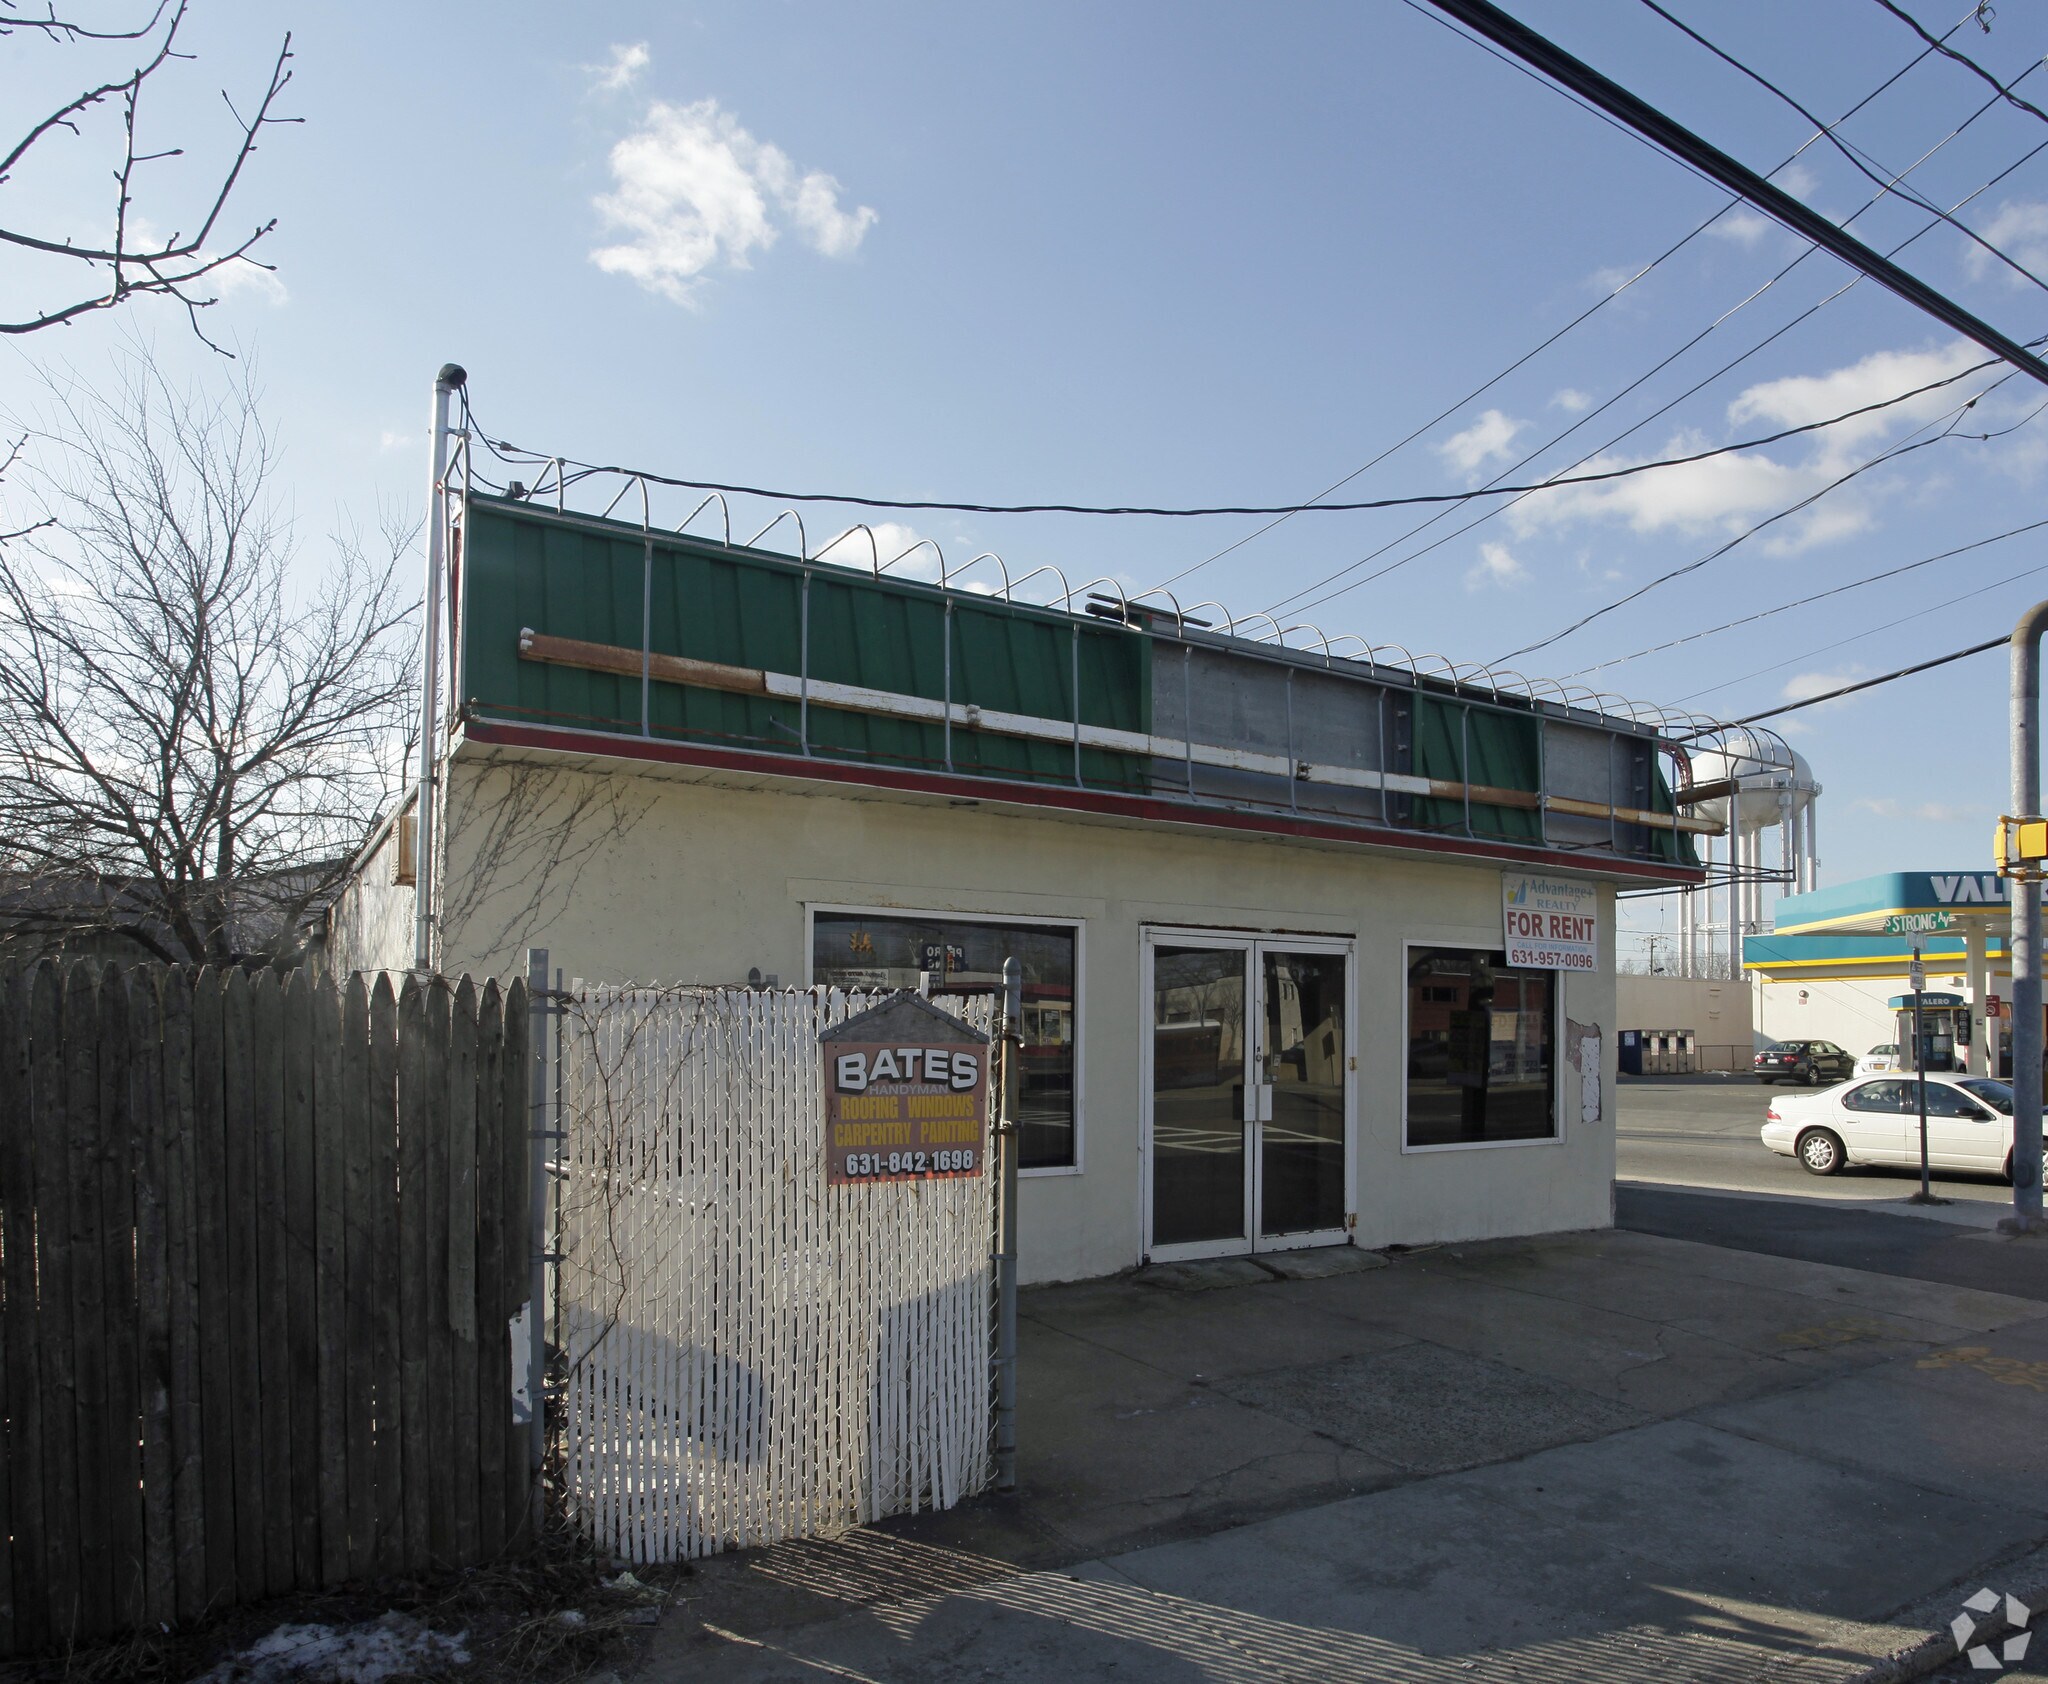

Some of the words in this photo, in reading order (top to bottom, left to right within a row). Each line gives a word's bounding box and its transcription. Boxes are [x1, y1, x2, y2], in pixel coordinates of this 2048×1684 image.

[1529, 879, 1594, 902] Advantage+
[1536, 899, 1578, 911] REALTY
[1506, 911, 1545, 938] FOR
[1549, 915, 1595, 941] RENT
[1885, 916, 1892, 927] S
[1892, 913, 1937, 933] STRONG
[1938, 911, 1950, 928] AV
[1511, 949, 1593, 968] 631-957-0096
[1517, 942, 1532, 950] CALL
[1534, 943, 1547, 951] FOR
[1548, 943, 1588, 953] INFORMATION
[835, 1047, 979, 1094] BATES
[869, 1084, 949, 1096] HANDYMAN
[840, 1096, 899, 1120] ROOFING
[907, 1094, 975, 1118] WINDOWS
[834, 1121, 912, 1147] CARPENTRY
[920, 1120, 979, 1144] PAINTING
